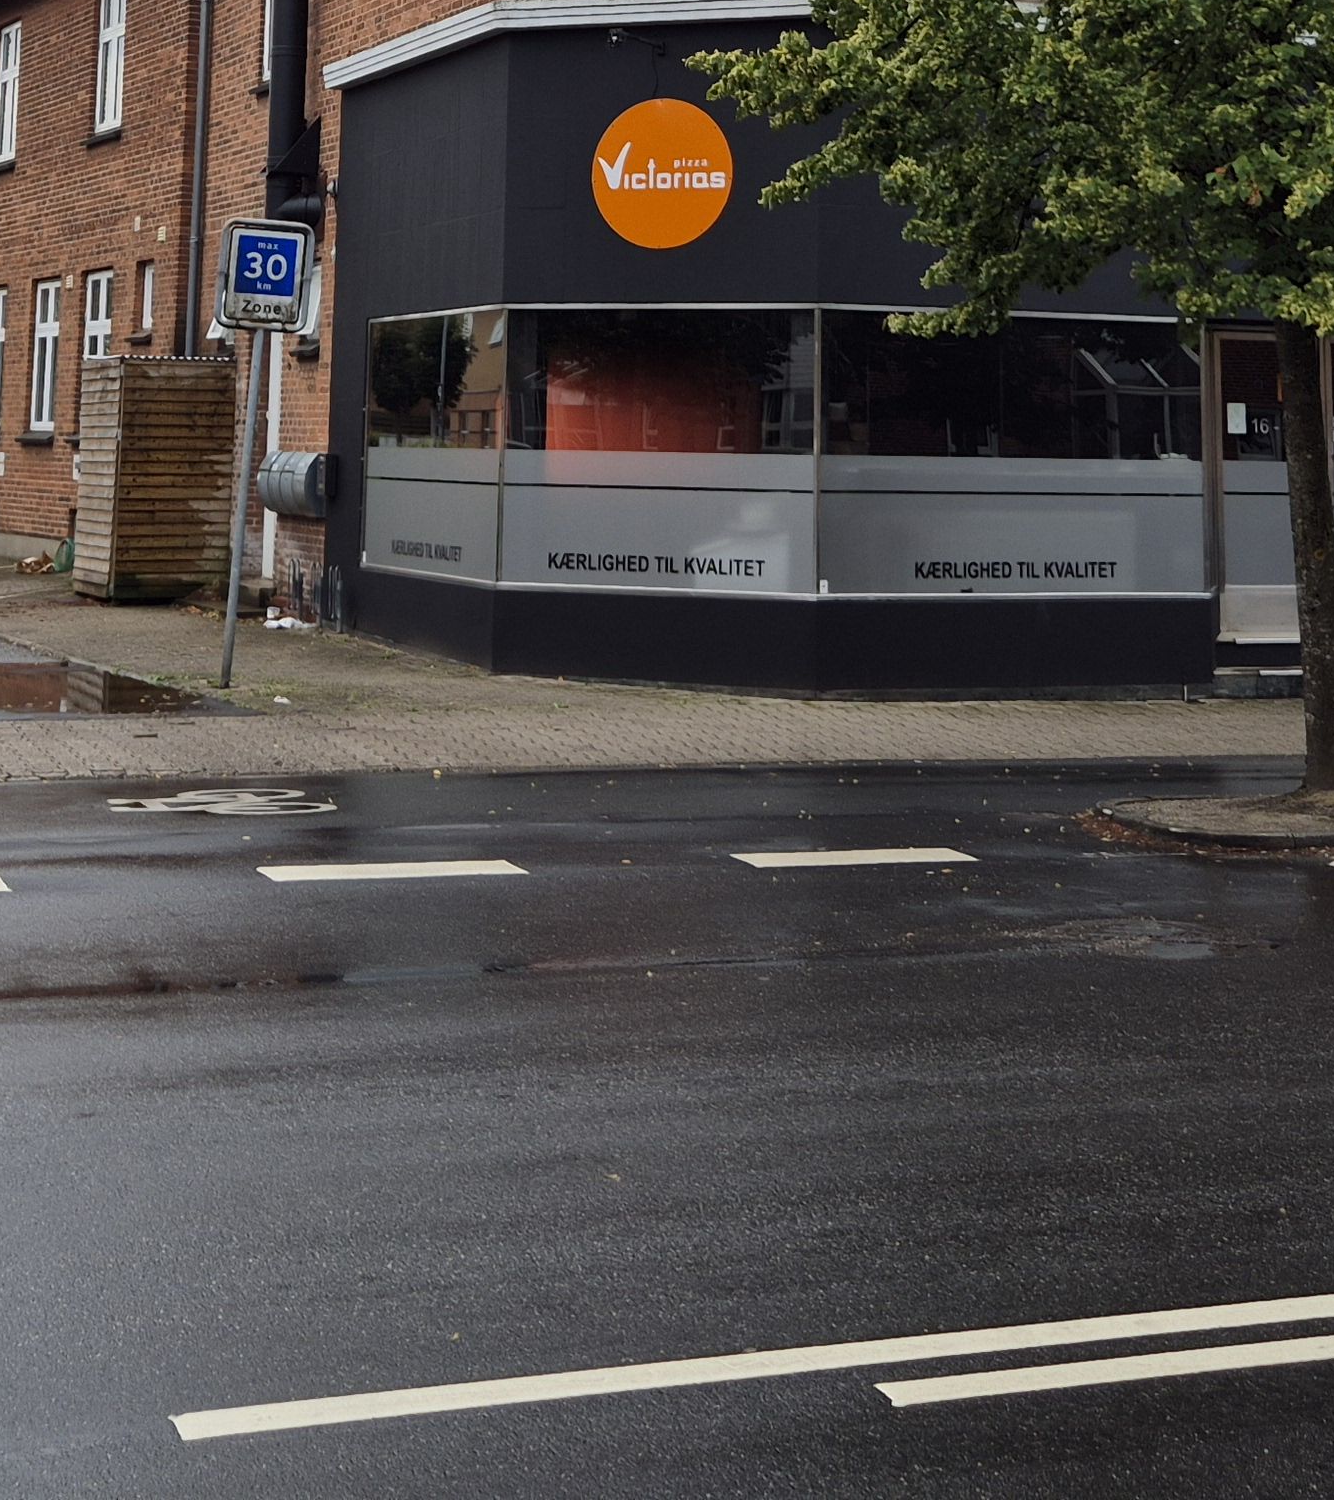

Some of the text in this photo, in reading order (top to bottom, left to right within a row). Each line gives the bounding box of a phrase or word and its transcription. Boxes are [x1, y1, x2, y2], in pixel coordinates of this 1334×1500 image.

[597, 141, 727, 190] Victorias
[673, 157, 709, 169] pizza
[257, 241, 279, 250] max
[243, 251, 287, 281] 30
[256, 281, 272, 291] km
[241, 299, 282, 315] Zone
[1251, 418, 1269, 434] 16
[547, 552, 766, 577] KÆRLIGHED TIL KVALITET
[914, 561, 1117, 579] KÆRLIGHED TIL KVALITET
